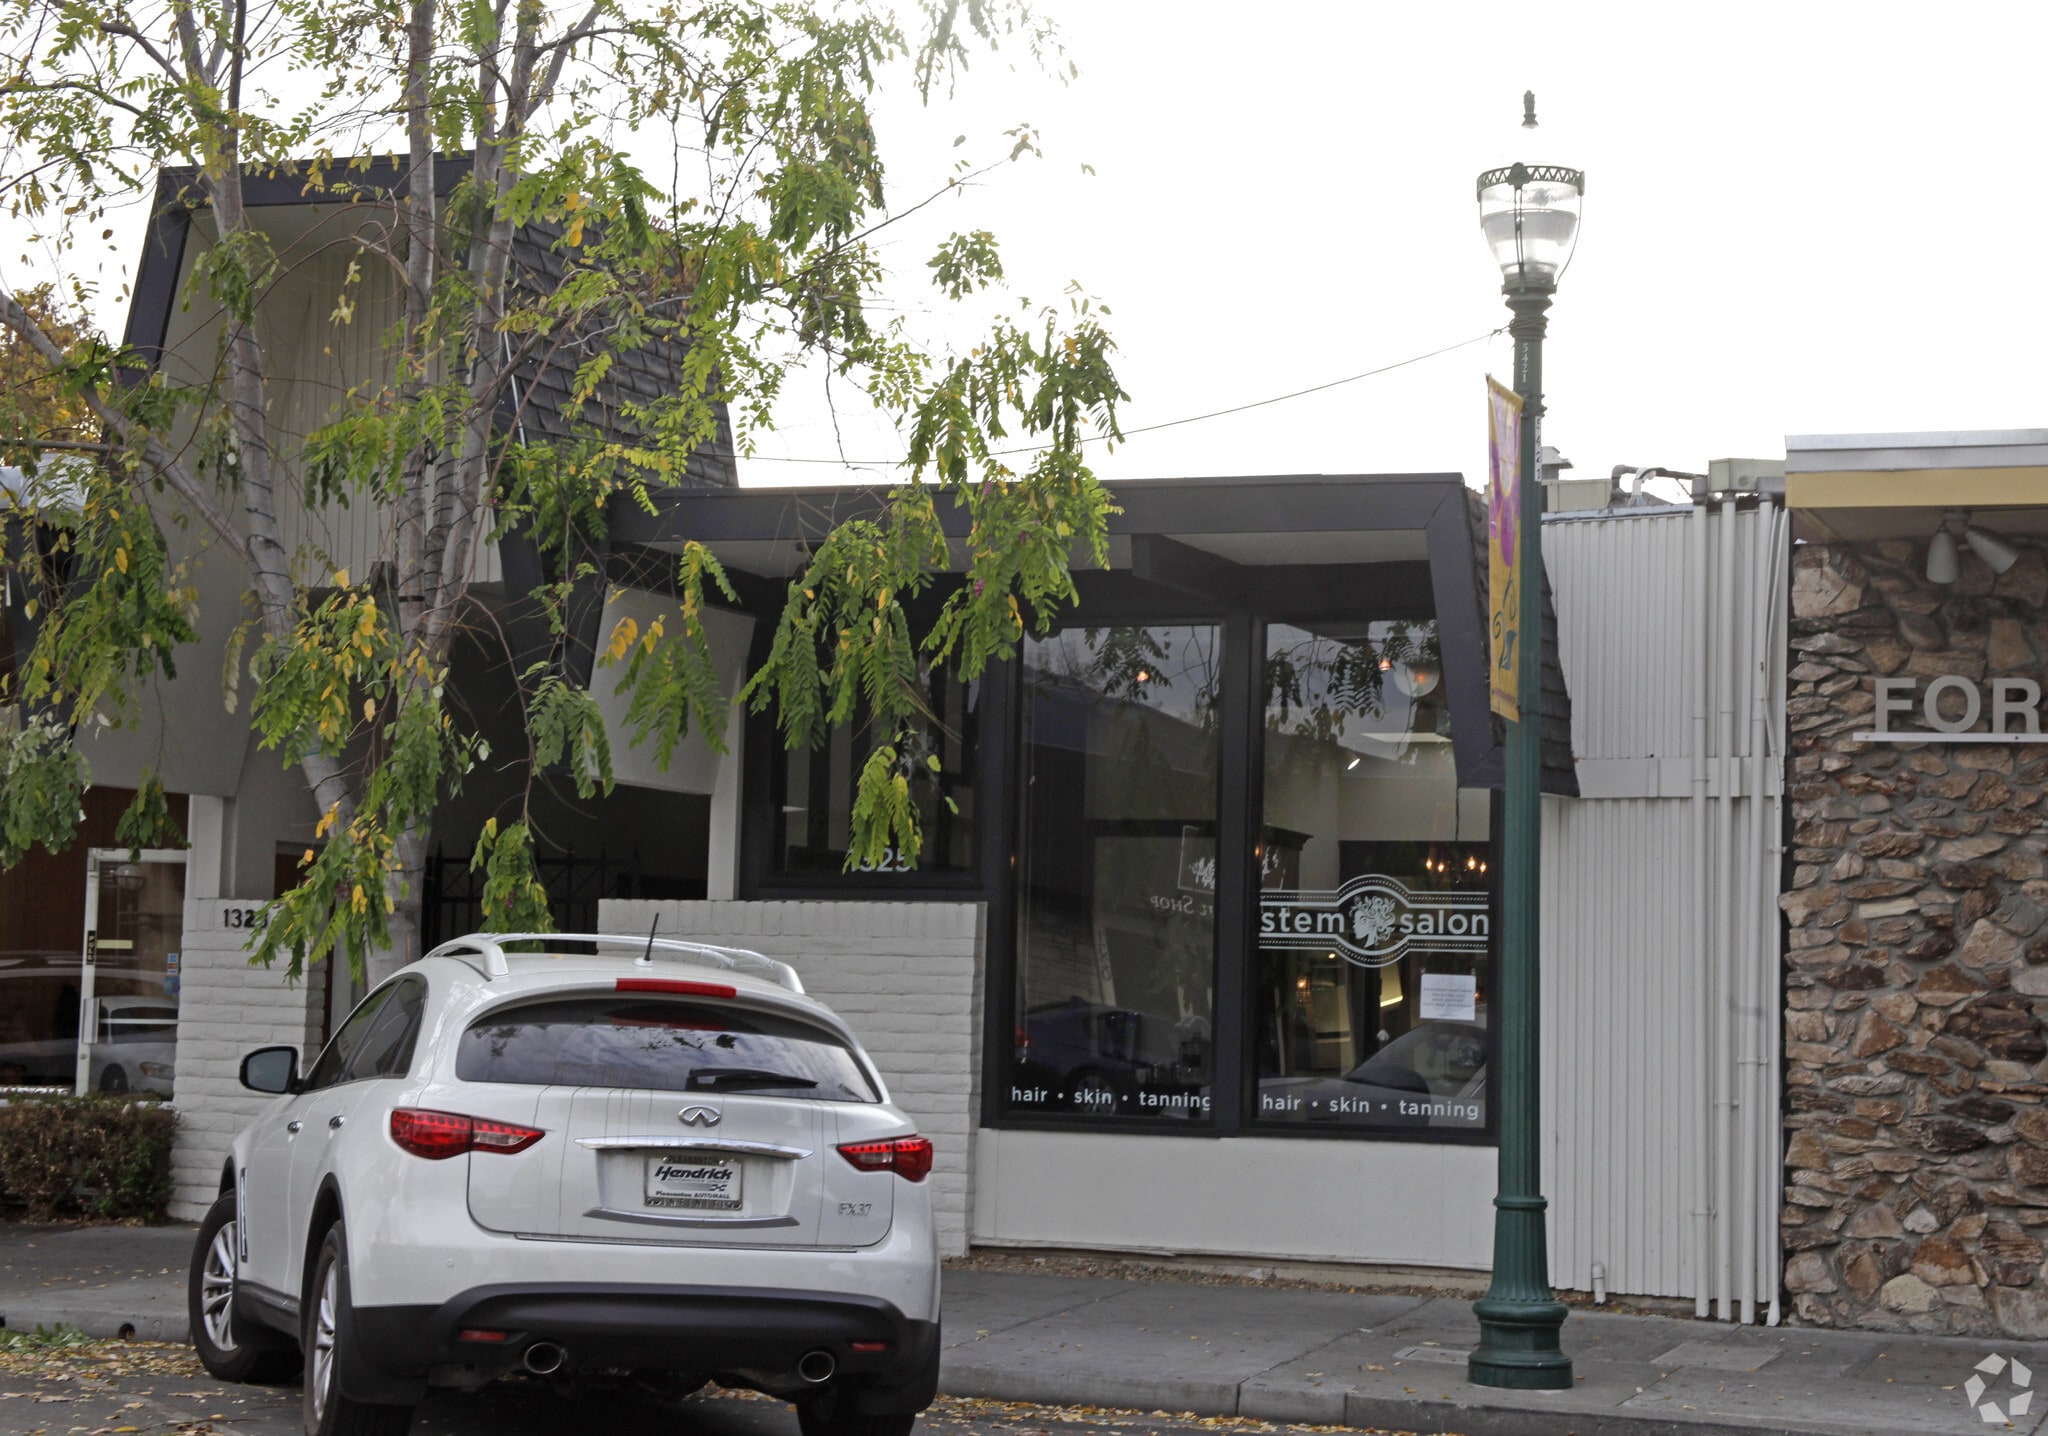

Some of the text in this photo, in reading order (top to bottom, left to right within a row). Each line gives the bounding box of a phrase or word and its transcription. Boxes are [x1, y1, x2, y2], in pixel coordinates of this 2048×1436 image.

[1875, 675, 2042, 733] FOR
[1260, 907, 1489, 935] stem salon
[1012, 1086, 1048, 1102] hair
[1074, 1088, 1112, 1104] skin
[1262, 1094, 1479, 1120] hair skin tanning
[655, 1166, 733, 1181] Hendrick
